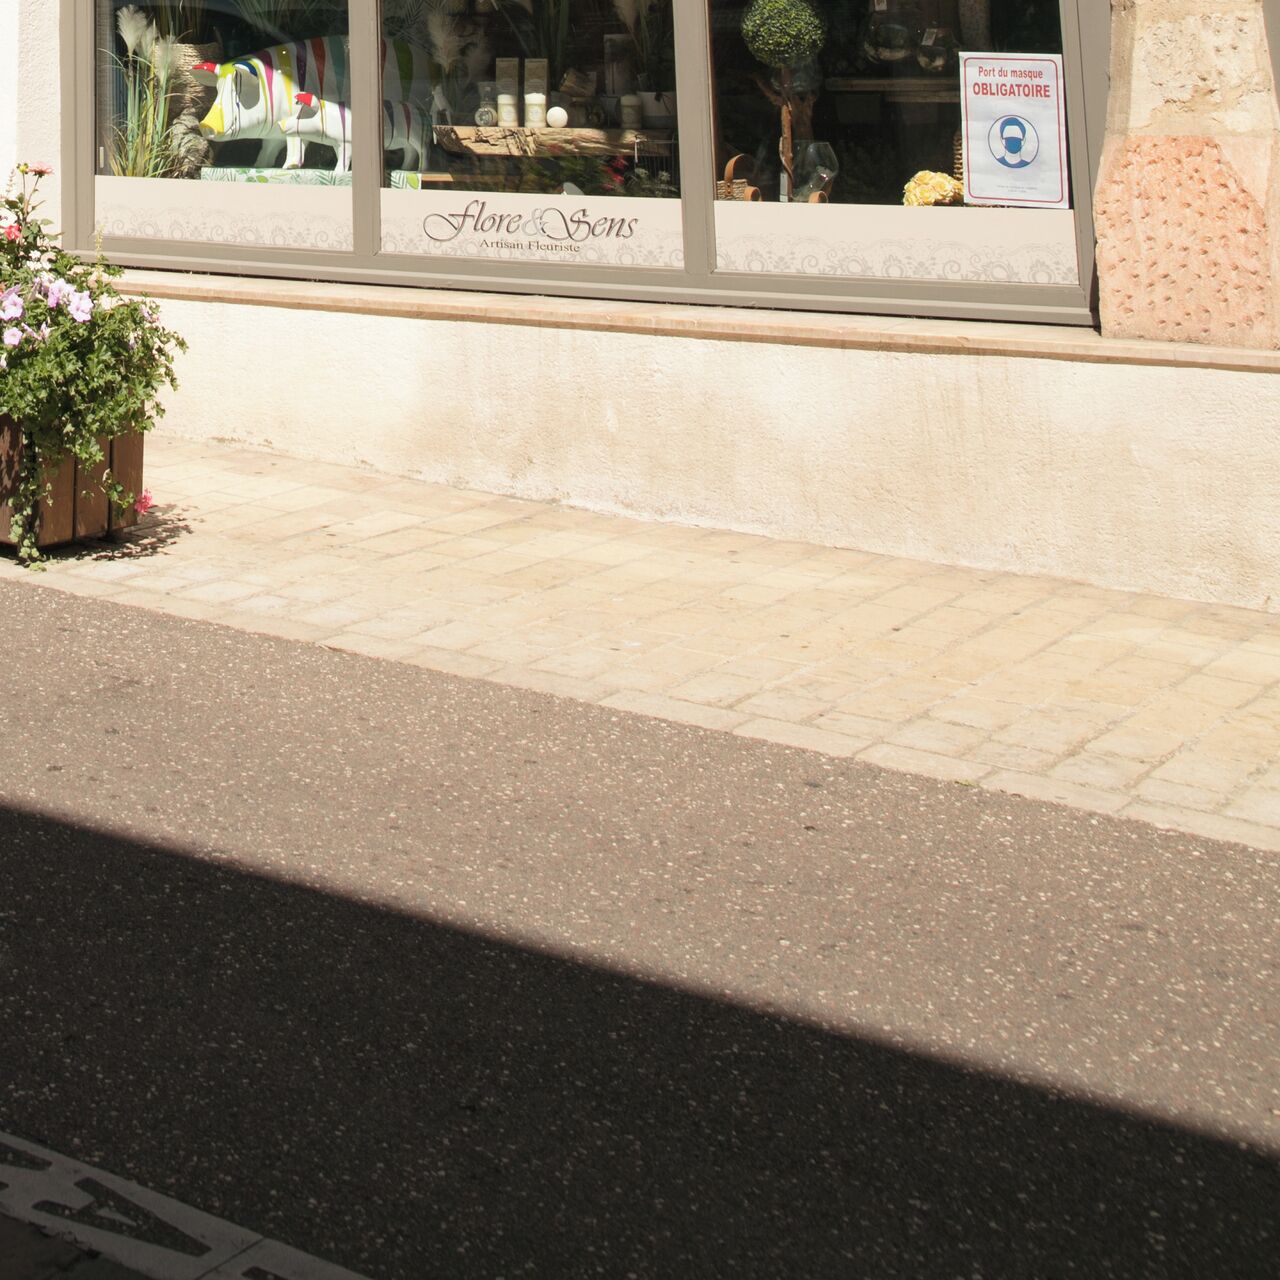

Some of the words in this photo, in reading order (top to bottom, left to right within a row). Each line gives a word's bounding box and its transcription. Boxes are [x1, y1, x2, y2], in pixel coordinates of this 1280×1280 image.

[978, 66, 996, 78] Port
[998, 67, 1008, 78] du
[1010, 70, 1044, 82] masque
[972, 82, 1051, 98] OBLIGATOIRE
[479, 239, 524, 251] Artisan
[528, 240, 581, 253] Fleuriste
